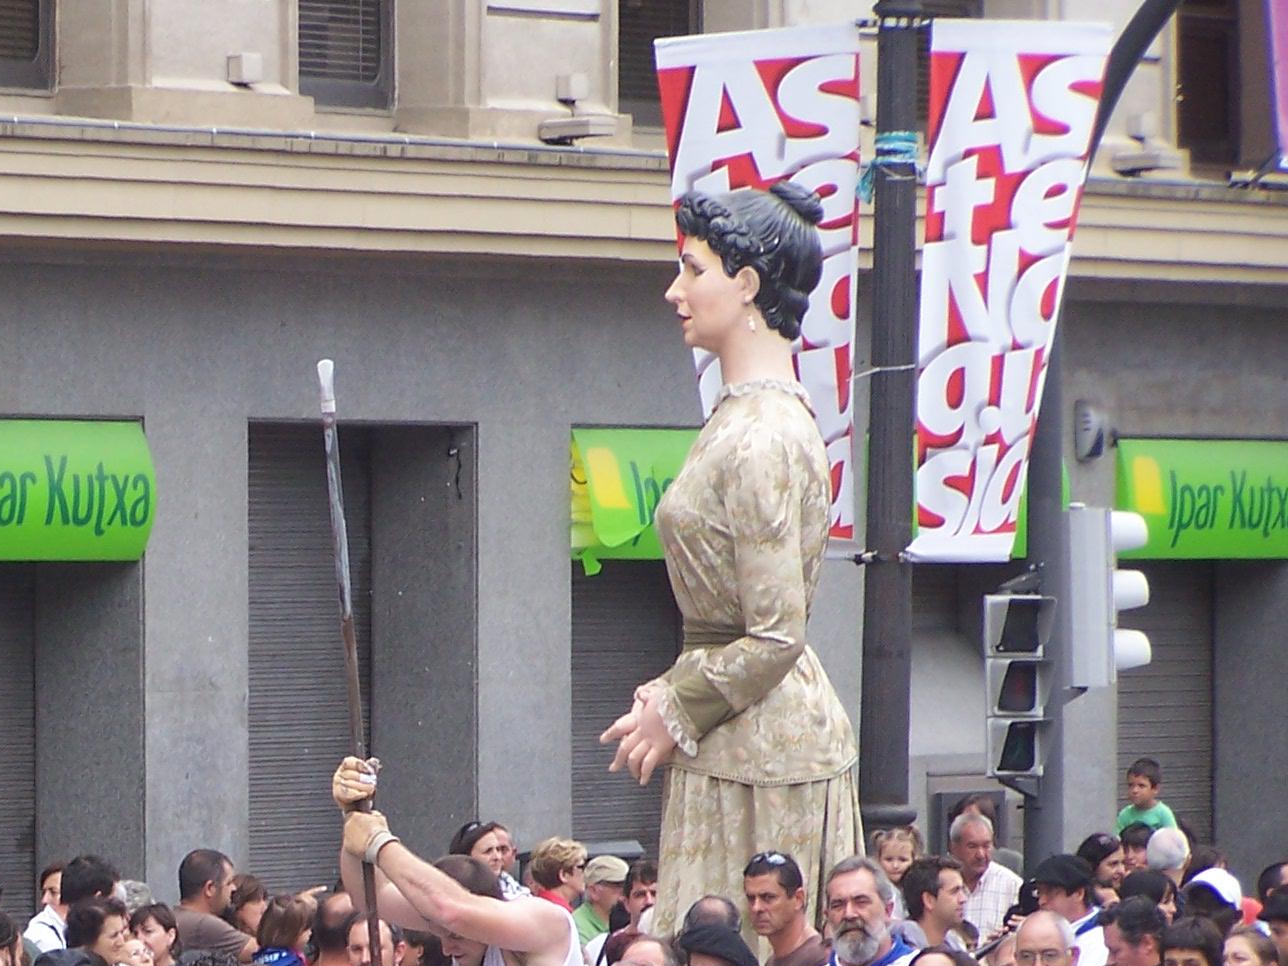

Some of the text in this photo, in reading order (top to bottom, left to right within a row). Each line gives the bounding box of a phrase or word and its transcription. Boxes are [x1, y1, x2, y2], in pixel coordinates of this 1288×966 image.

[672, 53, 859, 200] As
[927, 52, 1110, 186] As
[932, 154, 1086, 256] te
[43, 454, 150, 537] Kutxa
[1168, 470, 1288, 548] Ipar Kutx
